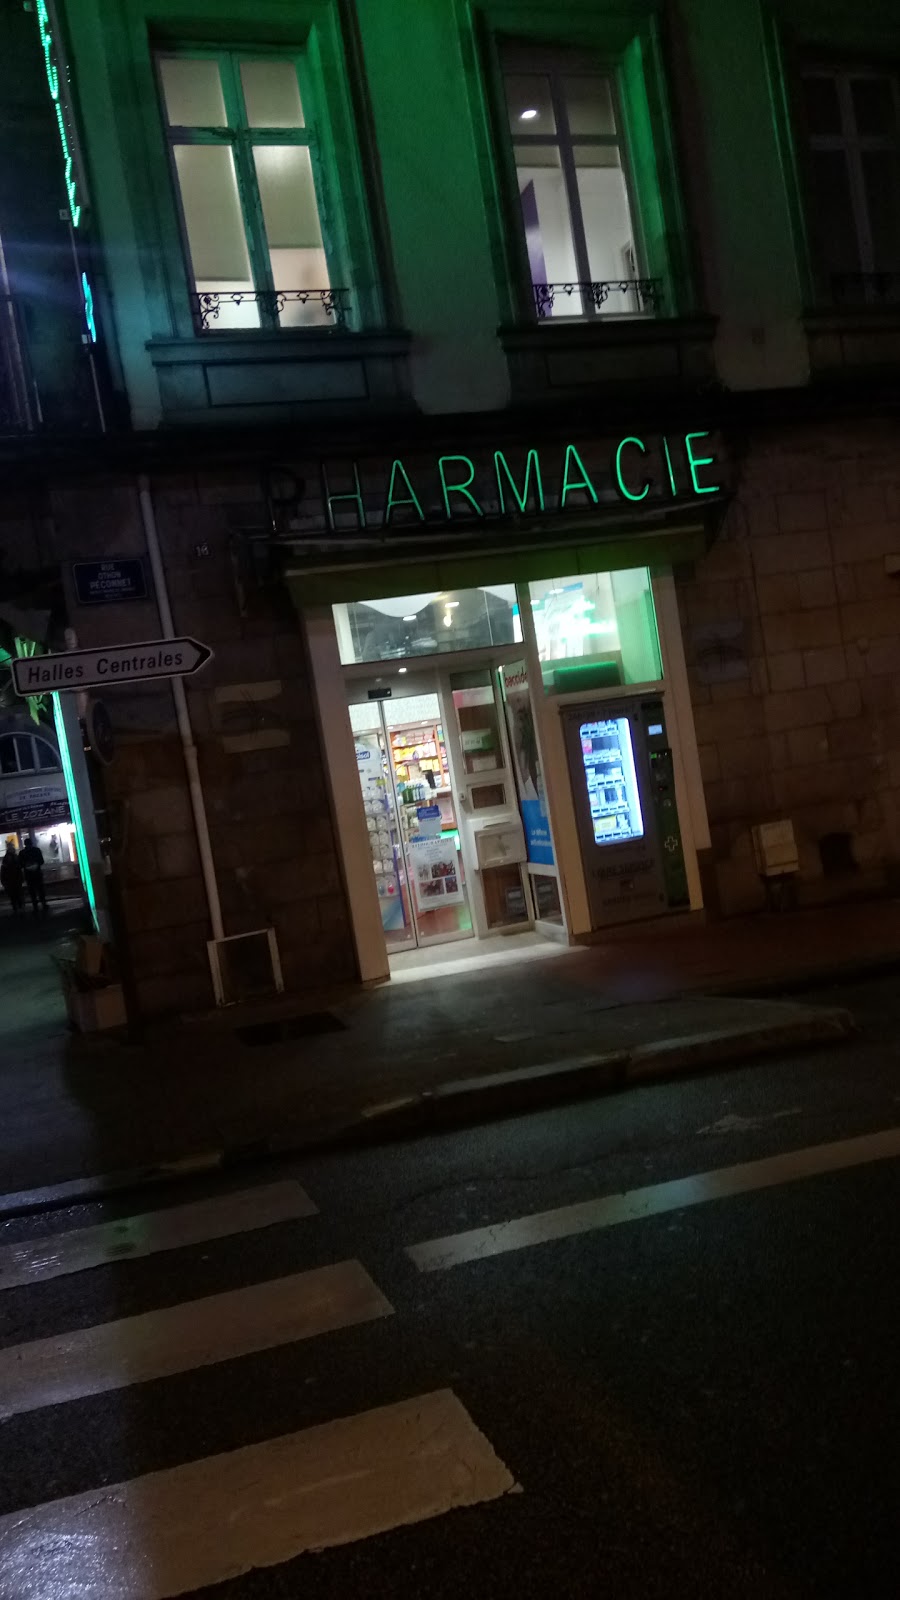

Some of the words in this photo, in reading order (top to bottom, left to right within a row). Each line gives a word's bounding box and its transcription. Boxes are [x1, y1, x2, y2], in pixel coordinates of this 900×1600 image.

[266, 431, 721, 535] PHARMACIE
[28, 663, 84, 684] Halles
[96, 651, 183, 675] Centrales
